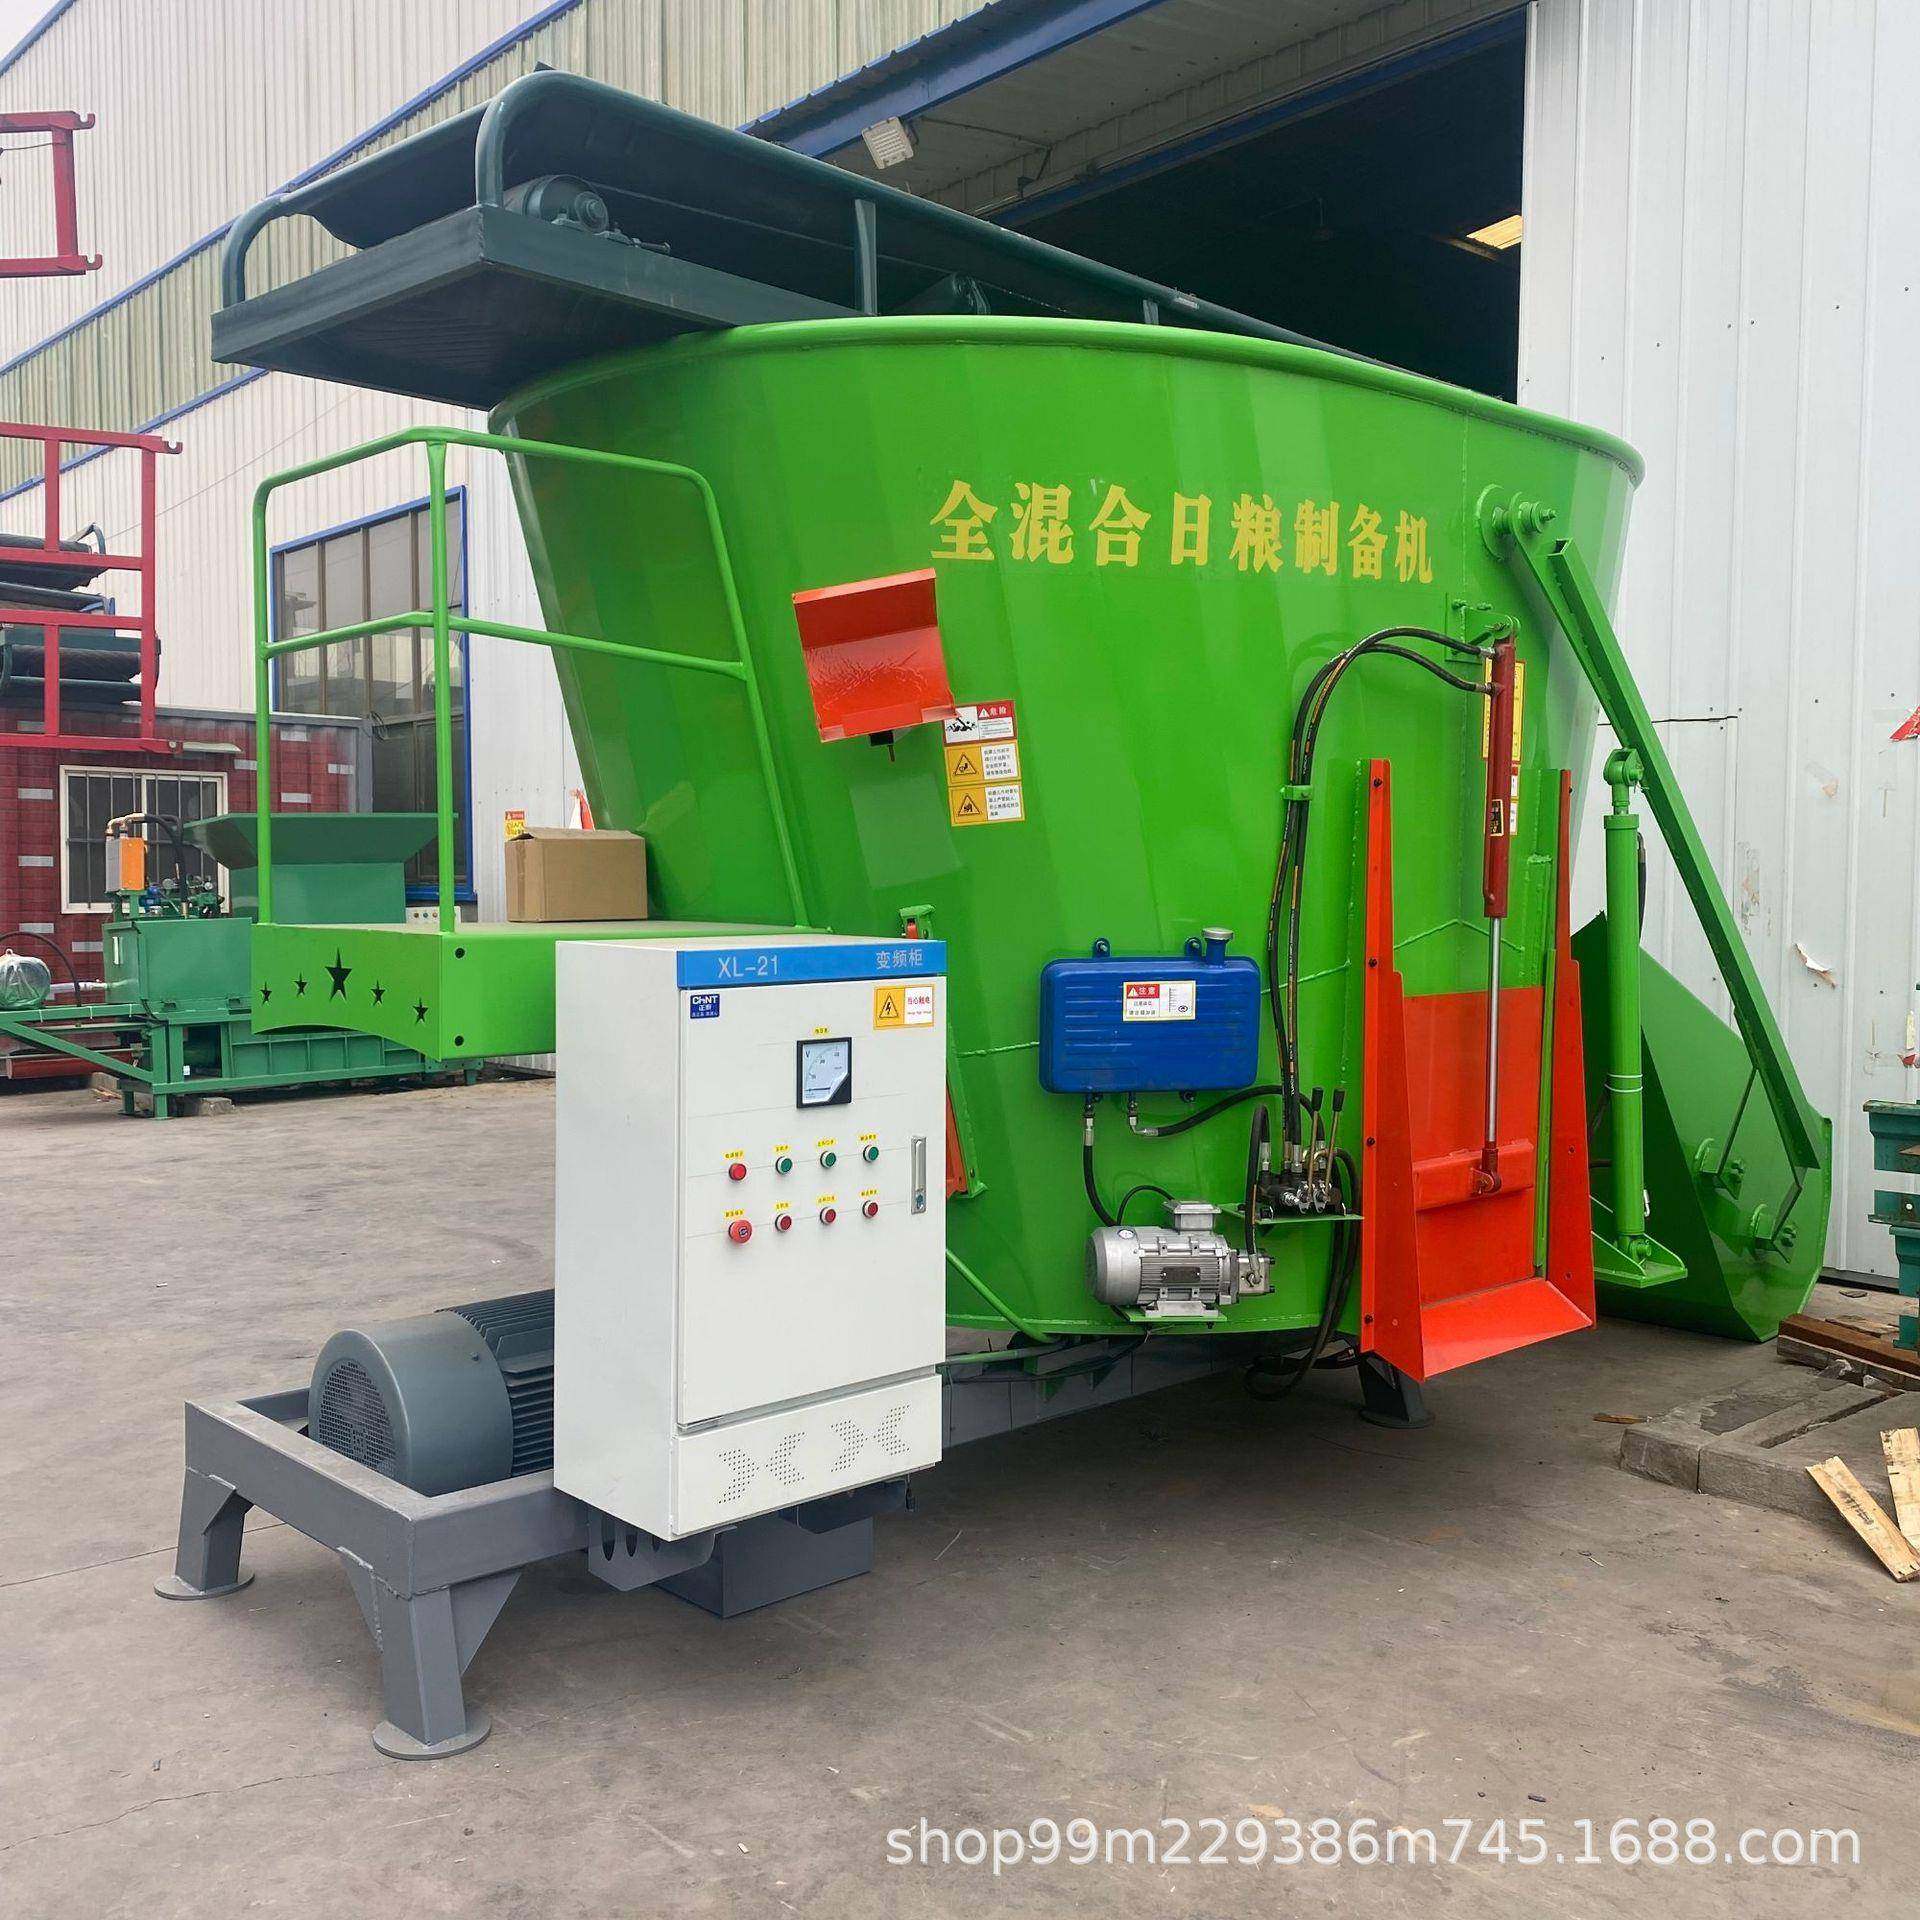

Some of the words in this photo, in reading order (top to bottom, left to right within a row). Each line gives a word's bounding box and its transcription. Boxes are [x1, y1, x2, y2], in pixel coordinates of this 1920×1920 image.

[930, 479, 1433, 584] 全混合日粮制备机
[717, 955, 779, 978] XL-21
[875, 948, 923, 970] 变频柜
[698, 1004, 711, 1012] 正
